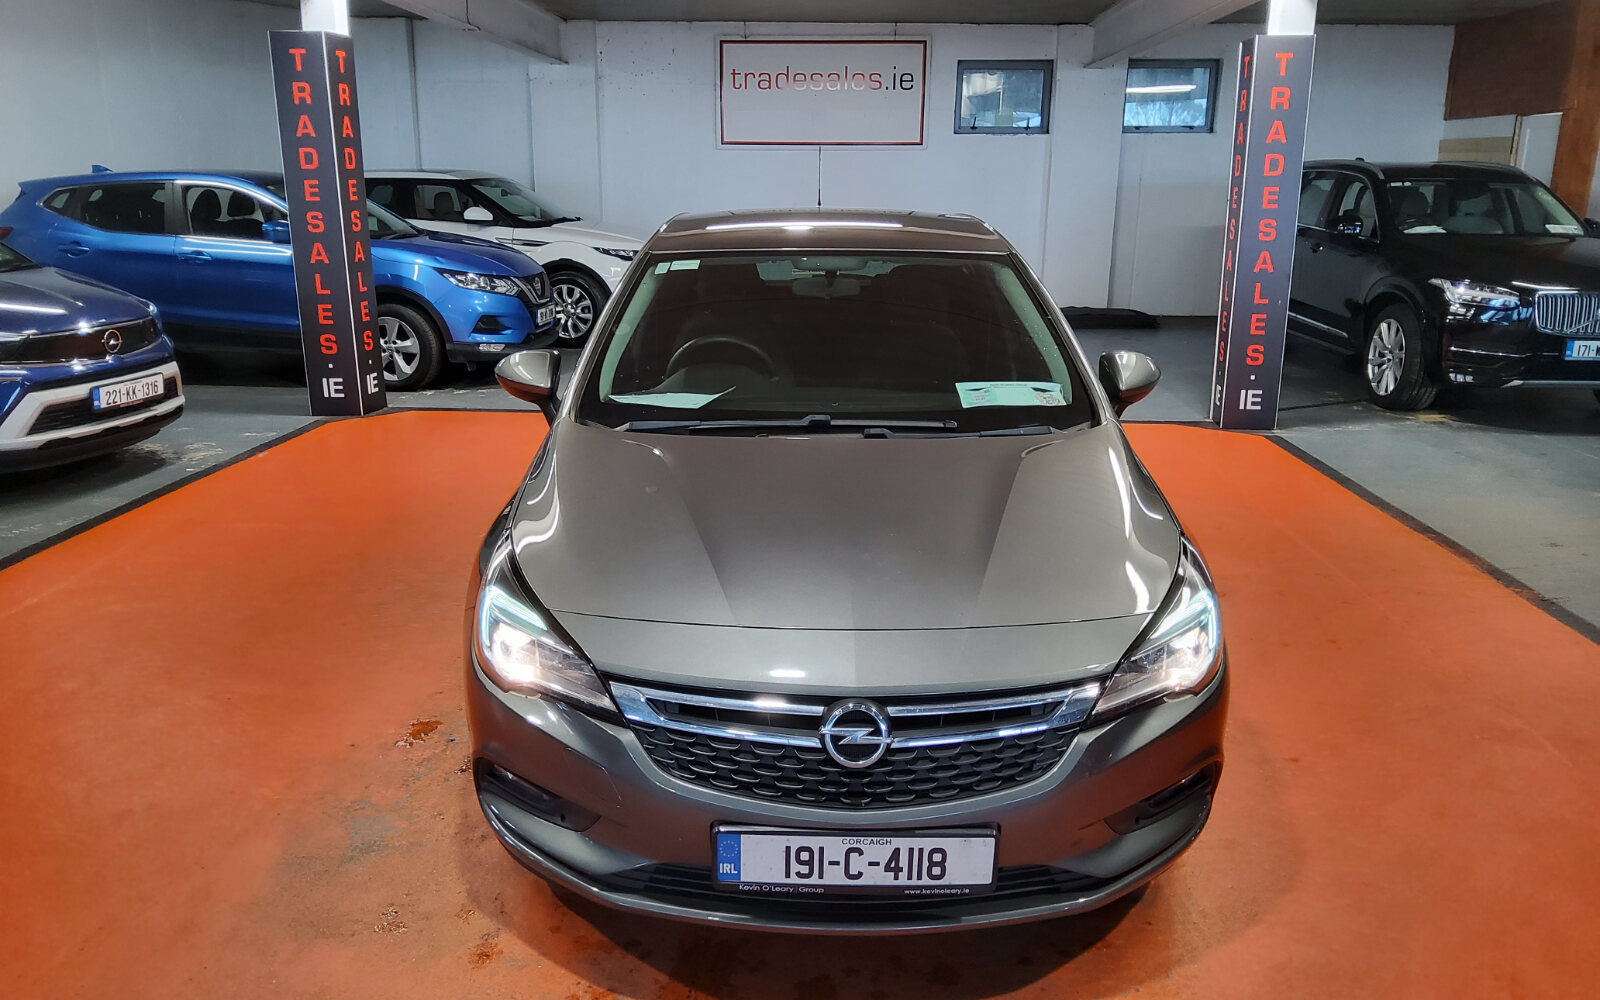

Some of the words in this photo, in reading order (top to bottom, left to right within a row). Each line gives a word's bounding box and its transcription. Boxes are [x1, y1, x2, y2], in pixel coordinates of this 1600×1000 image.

[730, 65, 914, 91] tradesales.ie
[105, 380, 159, 406] 221-KK-1316
[841, 838, 892, 846] CORCAIGH
[719, 862, 738, 874] IRL
[784, 845, 947, 881] 191-C-4118
[739, 883, 760, 891] Kevin
[762, 884, 794, 893] O'Leary
[798, 886, 824, 894] Group
